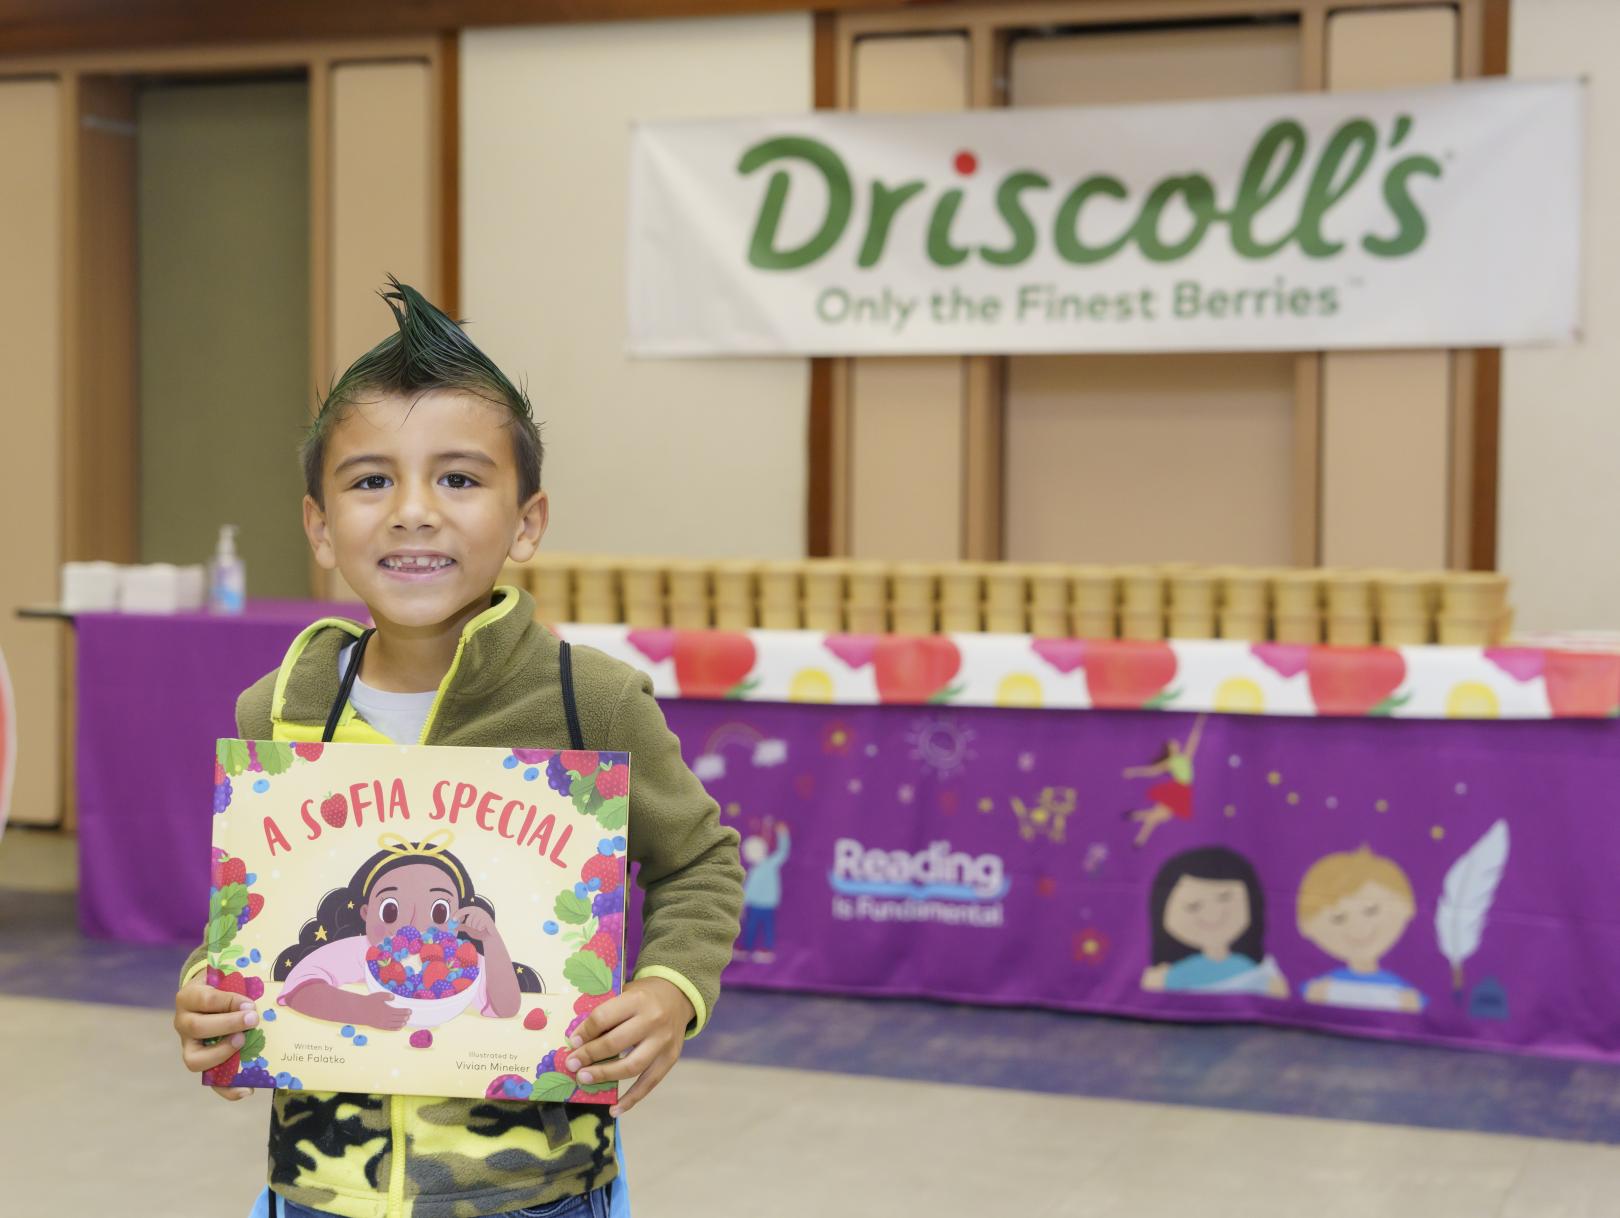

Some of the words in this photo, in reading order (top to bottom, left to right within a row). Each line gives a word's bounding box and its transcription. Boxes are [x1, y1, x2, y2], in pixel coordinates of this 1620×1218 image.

[737, 114, 1443, 271] Driscoll's
[816, 284, 916, 333] Only
[930, 285, 1002, 324] the
[1016, 282, 1155, 323] Finest
[1173, 274, 1340, 319] Berries
[263, 816, 292, 857] A
[429, 780, 574, 869] SPECIAL
[834, 837, 1004, 899] Reading
[280, 1052, 305, 1063] Julie
[307, 1053, 346, 1065] Falatko
[294, 1042, 321, 1052] Written
[324, 1043, 334, 1053] by
[468, 1050, 507, 1060] Illustrated
[509, 1052, 519, 1061] by
[455, 1060, 487, 1072] Vivian
[490, 1062, 531, 1074] Mineker
